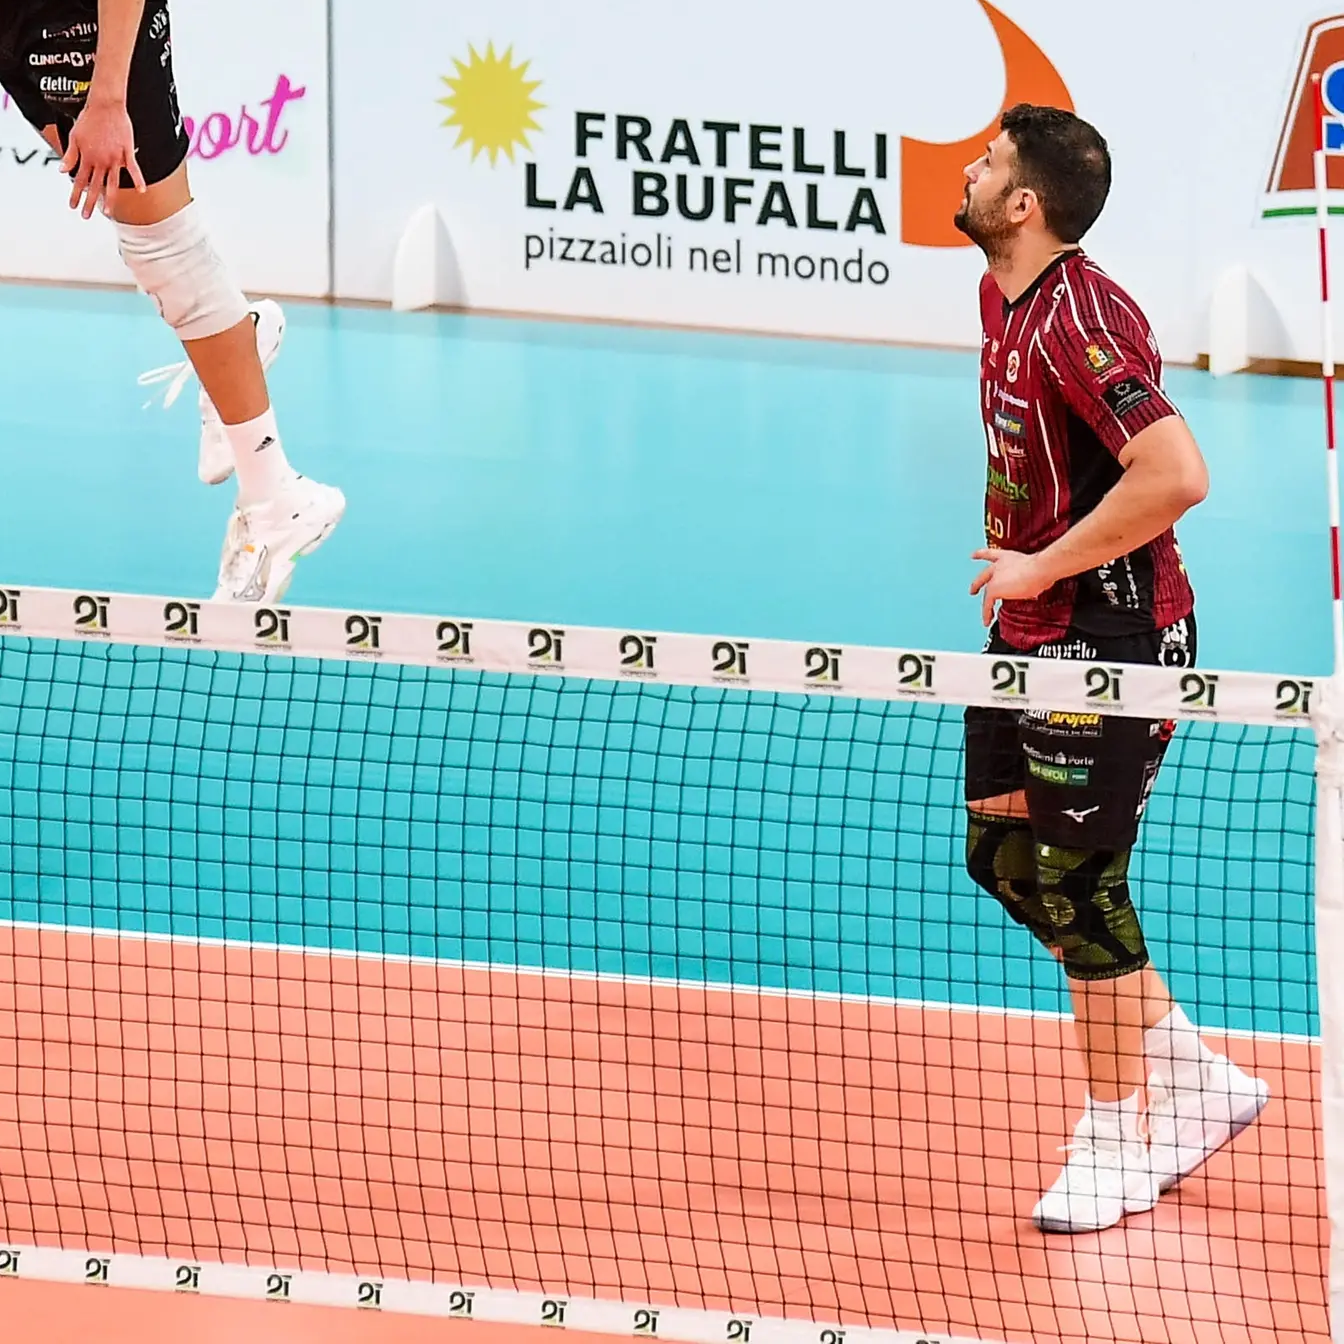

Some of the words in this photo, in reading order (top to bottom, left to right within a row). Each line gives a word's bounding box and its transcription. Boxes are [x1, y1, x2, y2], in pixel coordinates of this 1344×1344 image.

[574, 111, 888, 179] FRATELLI
[525, 162, 605, 214] LA
[632, 170, 887, 235] BUFALA
[524, 227, 674, 270] pizzaioli
[687, 239, 743, 275] nel
[756, 248, 891, 286] mondo
